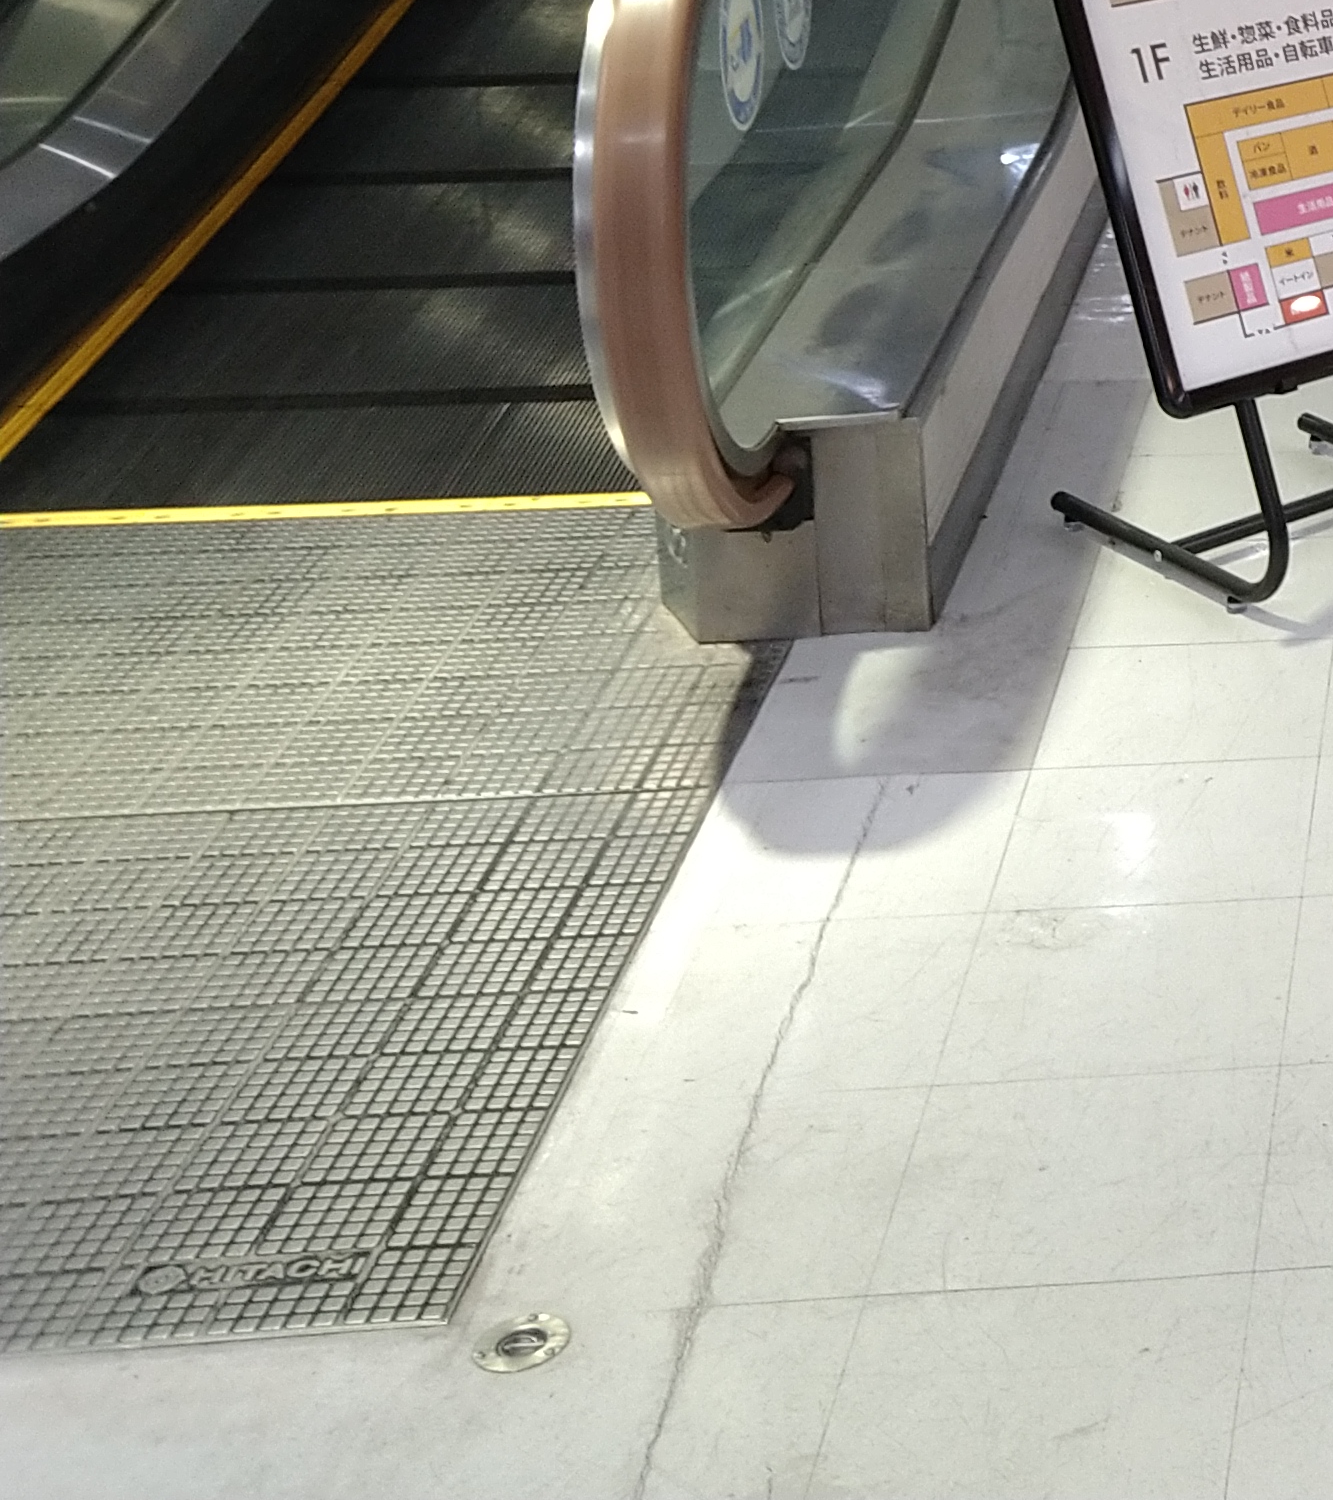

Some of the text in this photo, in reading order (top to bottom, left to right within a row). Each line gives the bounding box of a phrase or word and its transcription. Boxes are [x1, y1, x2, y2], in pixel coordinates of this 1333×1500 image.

[1130, 42, 1171, 84] 1F
[1232, 98, 1286, 118] デイリー食品
[1253, 141, 1271, 154] パン
[1249, 162, 1287, 180] 冷凍食品
[1279, 271, 1314, 286] イートイン
[189, 1254, 366, 1291] HITACHI
